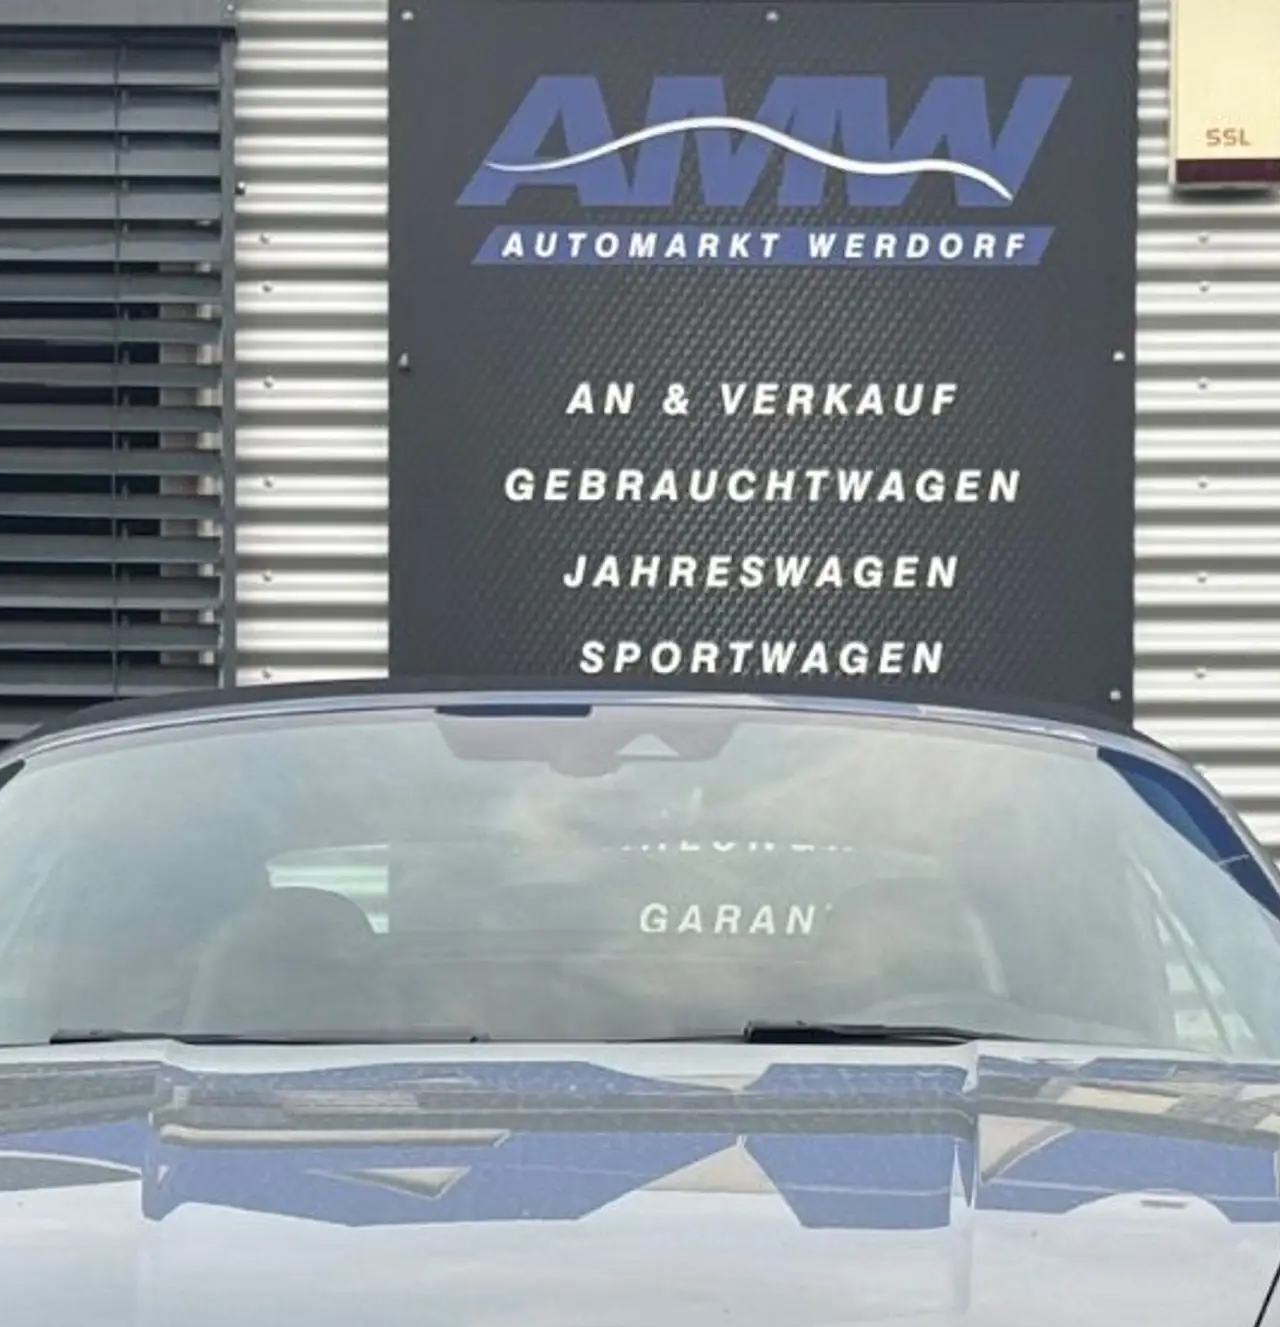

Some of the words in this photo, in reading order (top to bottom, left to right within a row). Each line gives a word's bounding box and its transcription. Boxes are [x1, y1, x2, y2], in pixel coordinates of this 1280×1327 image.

[455, 74, 1071, 208] AMW
[1205, 126, 1251, 147] SSL
[501, 231, 781, 259] AUTOMARKT
[808, 231, 1027, 260] WERDORF
[566, 382, 636, 416] AN
[662, 383, 690, 417] &
[721, 382, 959, 416] VERKAUF
[505, 468, 1021, 503] GEBRAUCHTWAGEN
[563, 555, 959, 589] JAHRESWAGEN
[579, 640, 944, 675] SPORTWAGEN
[639, 902, 832, 935] GARAN
